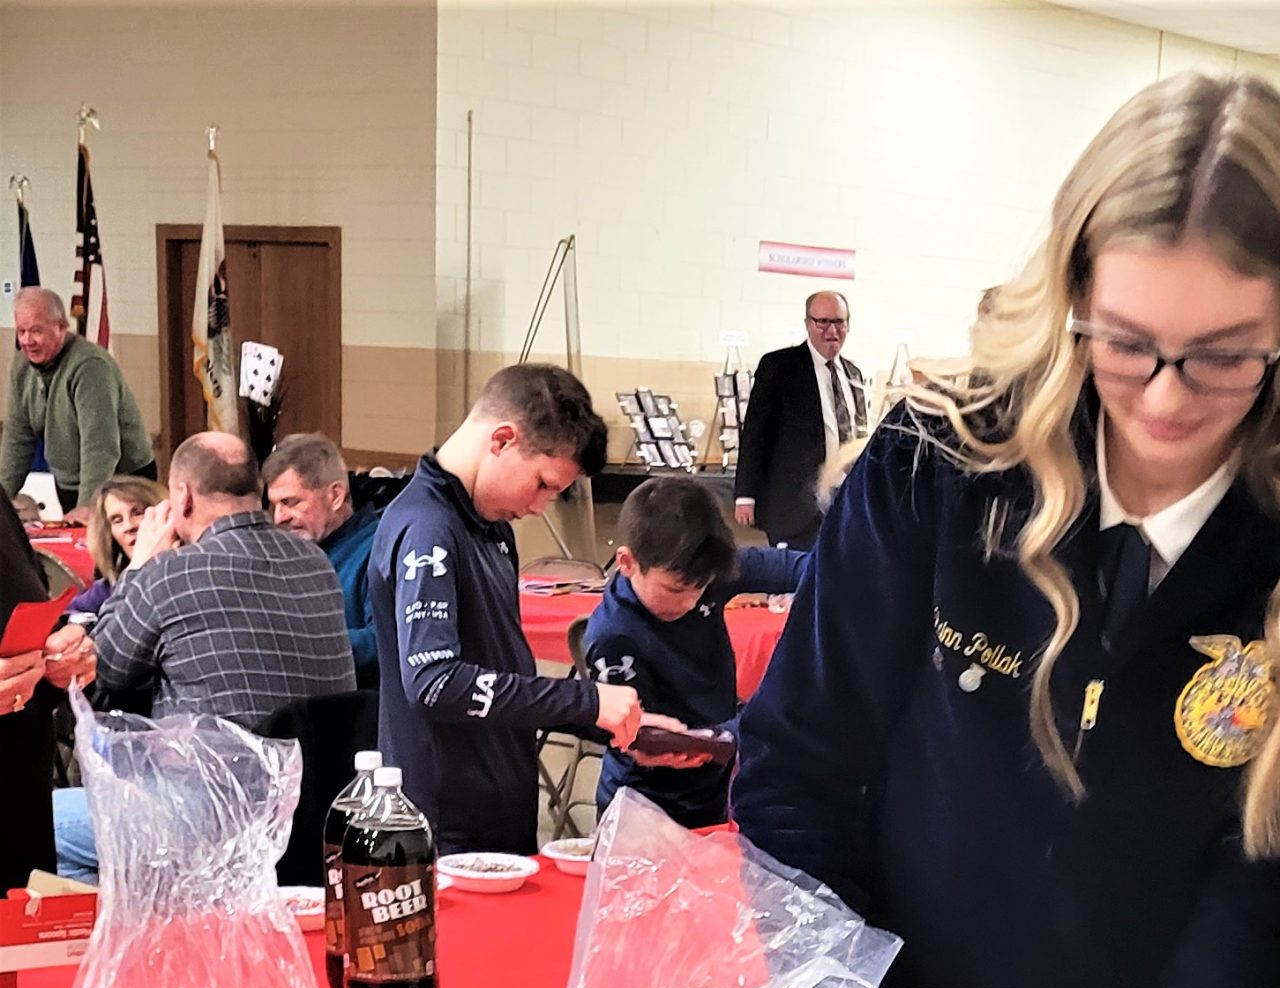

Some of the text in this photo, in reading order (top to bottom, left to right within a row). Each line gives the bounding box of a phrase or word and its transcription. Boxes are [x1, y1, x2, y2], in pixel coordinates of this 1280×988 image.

[963, 632, 1023, 678] Pollak
[361, 879, 422, 910] ROOT
[371, 894, 428, 924] BEER
